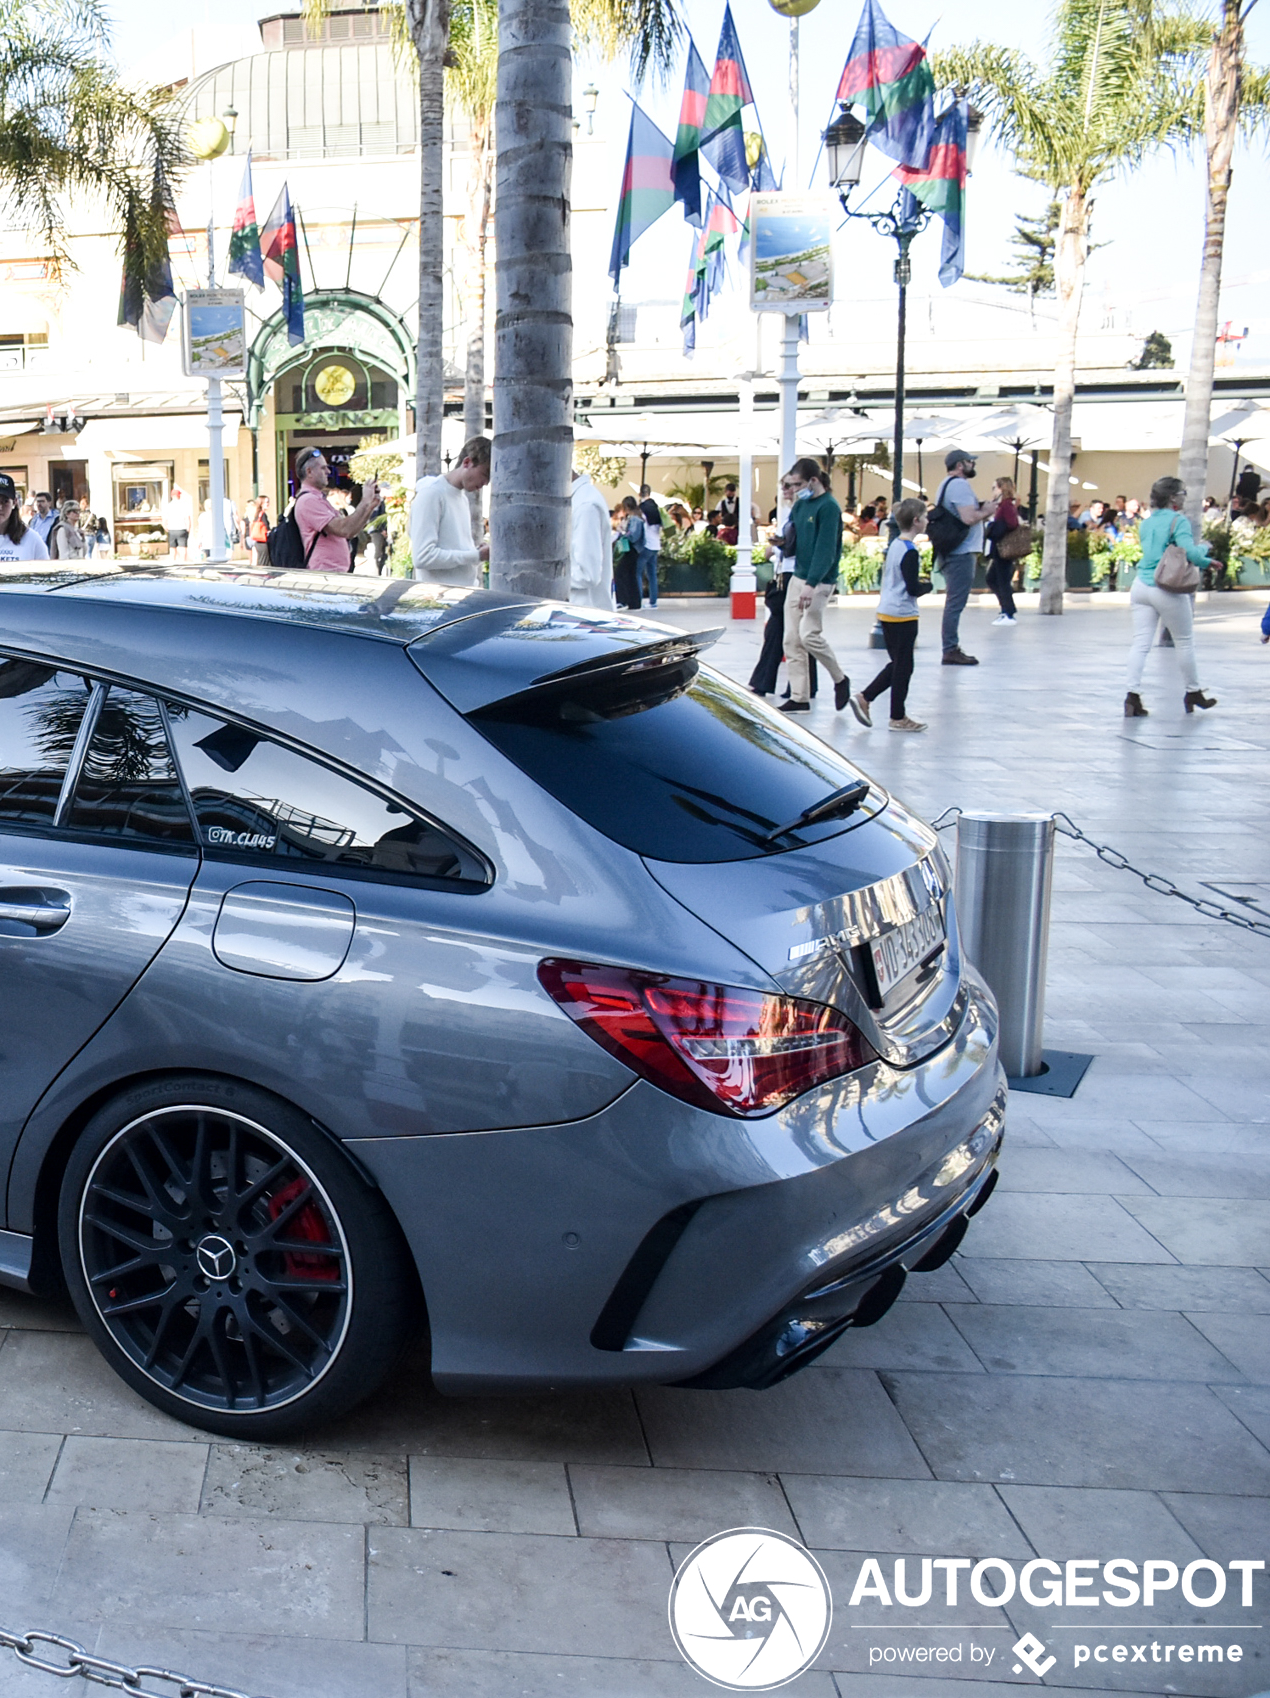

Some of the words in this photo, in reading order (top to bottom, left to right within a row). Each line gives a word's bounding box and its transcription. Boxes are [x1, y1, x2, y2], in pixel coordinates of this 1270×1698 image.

[321, 386, 349, 394] CASINO
[299, 412, 375, 427] CASINO
[815, 925, 860, 951] AMG
